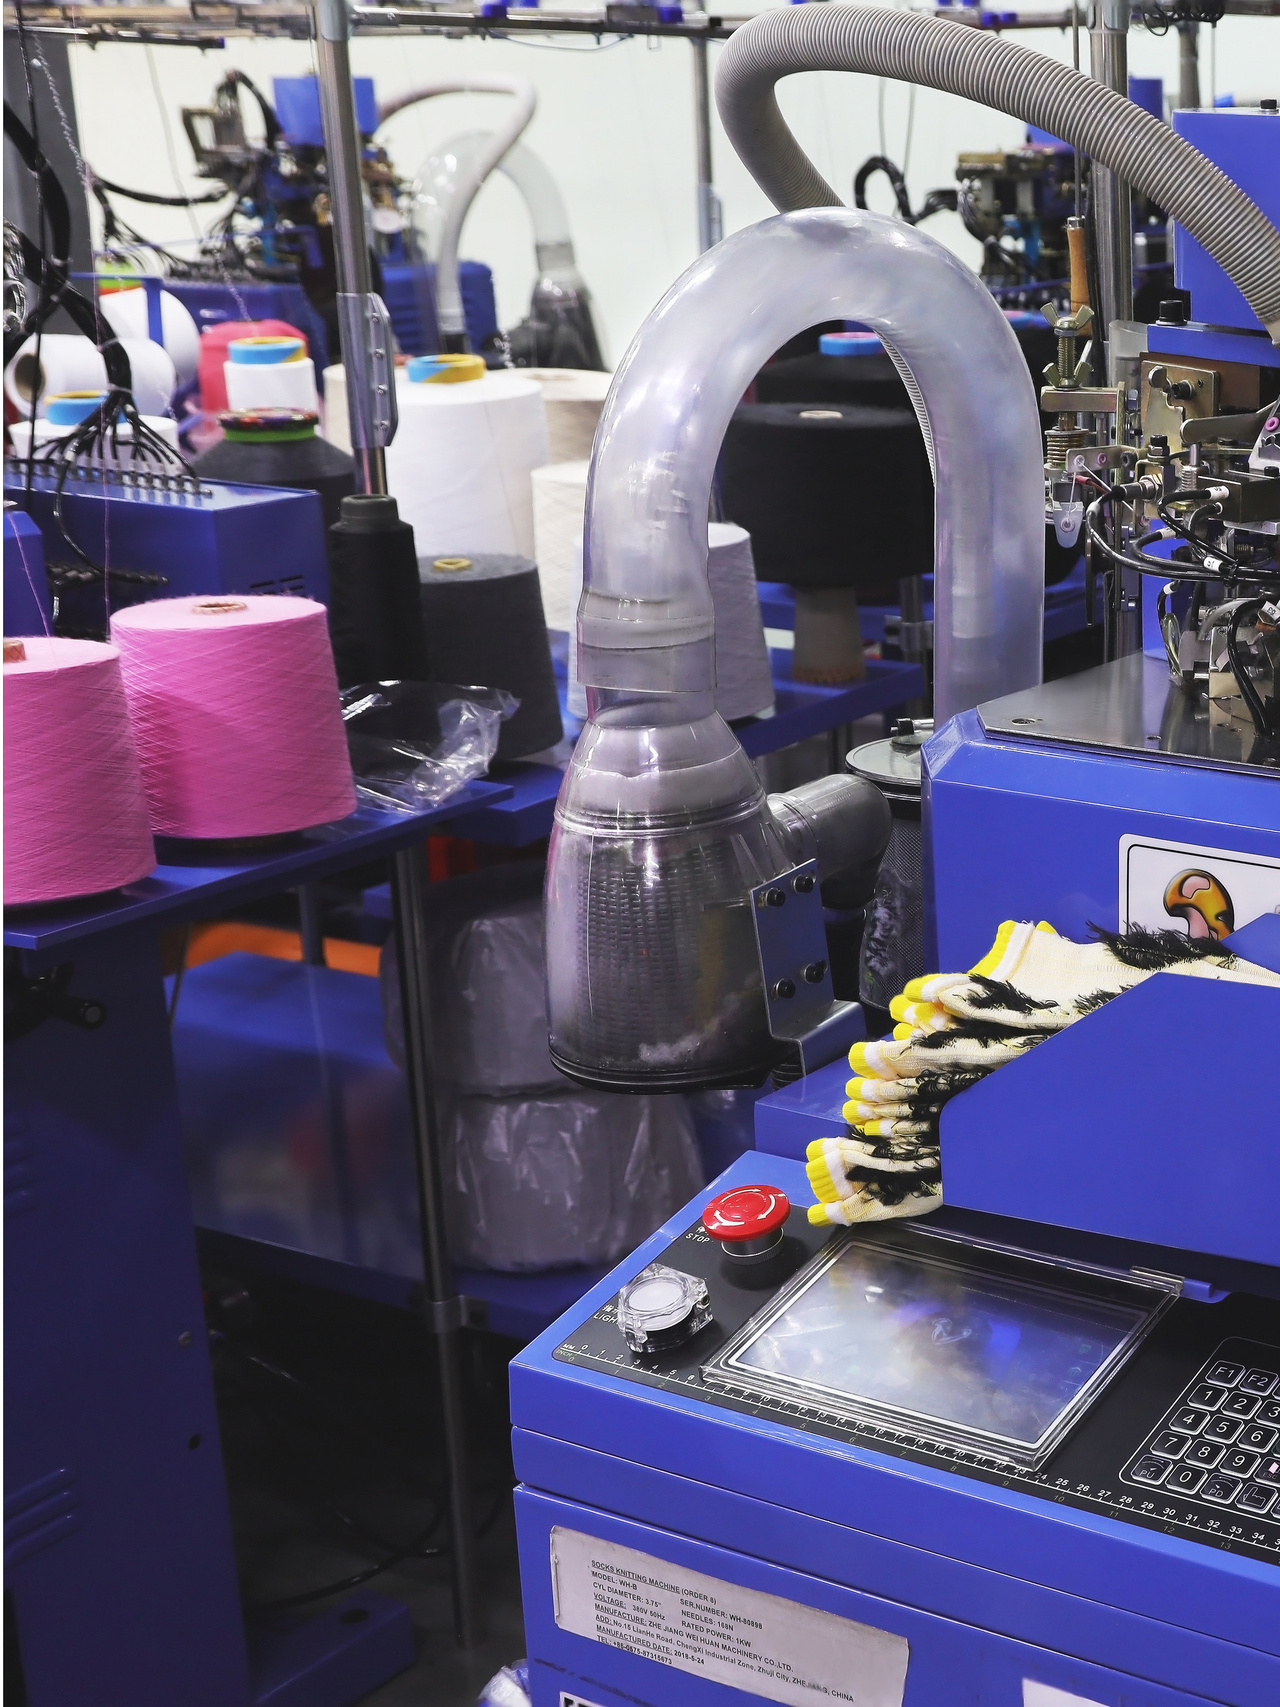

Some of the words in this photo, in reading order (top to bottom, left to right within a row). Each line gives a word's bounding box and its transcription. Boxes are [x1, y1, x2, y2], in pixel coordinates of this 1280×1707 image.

[686, 1233, 710, 1243] STOP
[1215, 1367, 1235, 1378] F1
[1247, 1374, 1268, 1386] F2
[1204, 1390, 1213, 1400] 1
[1233, 1398, 1247, 1409] 2
[1268, 1406, 1280, 1417] 3
[1183, 1414, 1195, 1424] 4
[1216, 1422, 1230, 1432] 5
[1251, 1431, 1263, 1442] 6
[1164, 1437, 1178, 1448] 7
[1198, 1446, 1210, 1457] 8
[1232, 1455, 1245, 1466] 9
[1140, 1470, 1155, 1479] PU
[1180, 1471, 1192, 1482] 0
[1208, 1488, 1224, 1497] PD
[1055, 1477, 1069, 1486] 25
[1076, 1483, 1089, 1491] 26
[1097, 1489, 1111, 1498] 27
[1119, 1495, 1132, 1504] 28
[1140, 1501, 1153, 1509] 29
[1163, 1507, 1175, 1515] 30
[1185, 1513, 1197, 1521] 31
[1207, 1519, 1220, 1528] 32
[1229, 1526, 1242, 1534] 33
[1252, 1532, 1264, 1540] 34
[591, 1570, 617, 1584] MODEL:
[618, 1579, 637, 1590] WH-B
[591, 1559, 614, 1573] SOCKS
[616, 1567, 646, 1583] KNITTING
[648, 1577, 679, 1593] MACHINE
[681, 1587, 708, 1602] (ORDER
[593, 1582, 606, 1591] CYL
[607, 1586, 643, 1603] DIAMETER:
[681, 1610, 715, 1626] NEEDLES:
[594, 1592, 626, 1608] VOLTAGE:
[632, 1604, 647, 1614] 380V
[681, 1620, 704, 1633] RATED
[706, 1628, 733, 1642] POWER:
[735, 1637, 751, 1647] 1KW
[594, 1603, 646, 1625] MANUFACTURE:
[648, 1620, 661, 1630] ZHE
[663, 1625, 683, 1637] JIANG
[685, 1632, 698, 1641] WEI
[700, 1636, 719, 1648] HUAN
[721, 1643, 762, 1662] MACHINERY
[596, 1624, 651, 1647] MANUFACTURED
[652, 1642, 672, 1654] DATE:
[597, 1634, 611, 1645] TEL:
[632, 1625, 654, 1638] LianHe
[656, 1633, 674, 1645] Road,
[705, 1649, 735, 1664] Industrial
[737, 1659, 755, 1671] Zone,
[757, 1665, 774, 1678] Zhuji
[776, 1671, 790, 1683] City,
[832, 1690, 853, 1702] CHINA
